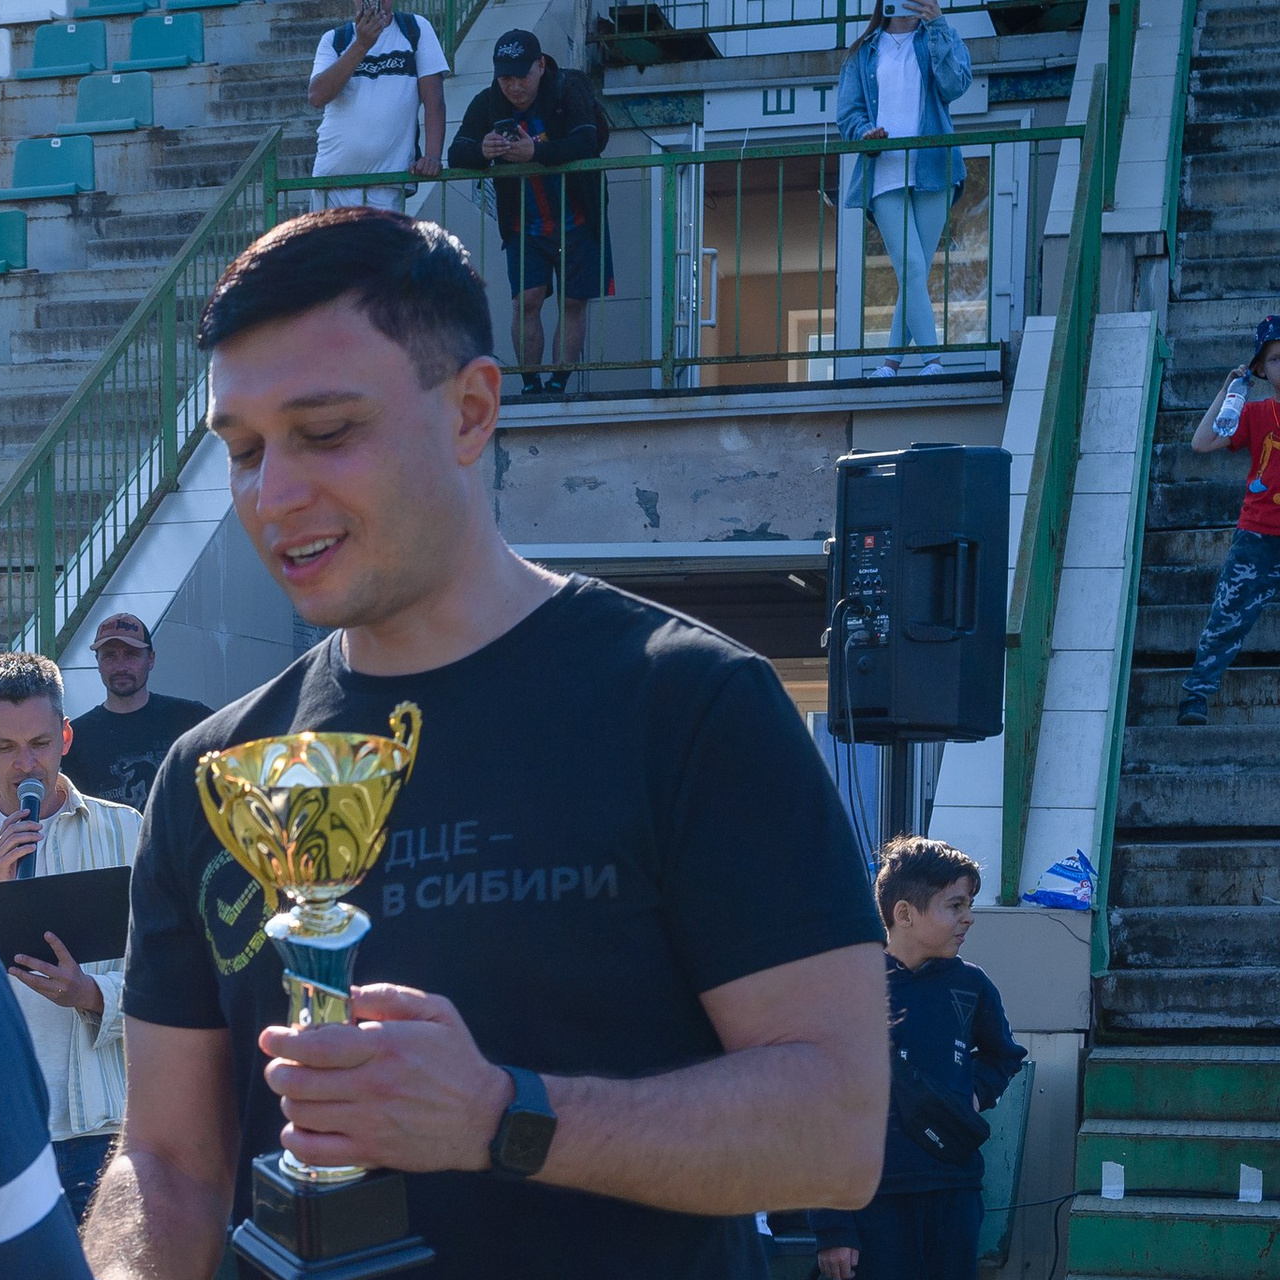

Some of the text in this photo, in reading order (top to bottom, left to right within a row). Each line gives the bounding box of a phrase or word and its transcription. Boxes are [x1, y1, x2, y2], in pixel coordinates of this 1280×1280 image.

[762, 86, 834, 116] ШТ
[384, 820, 479, 871] ДЦЕ
[382, 863, 618, 918] В СИБИРИ
